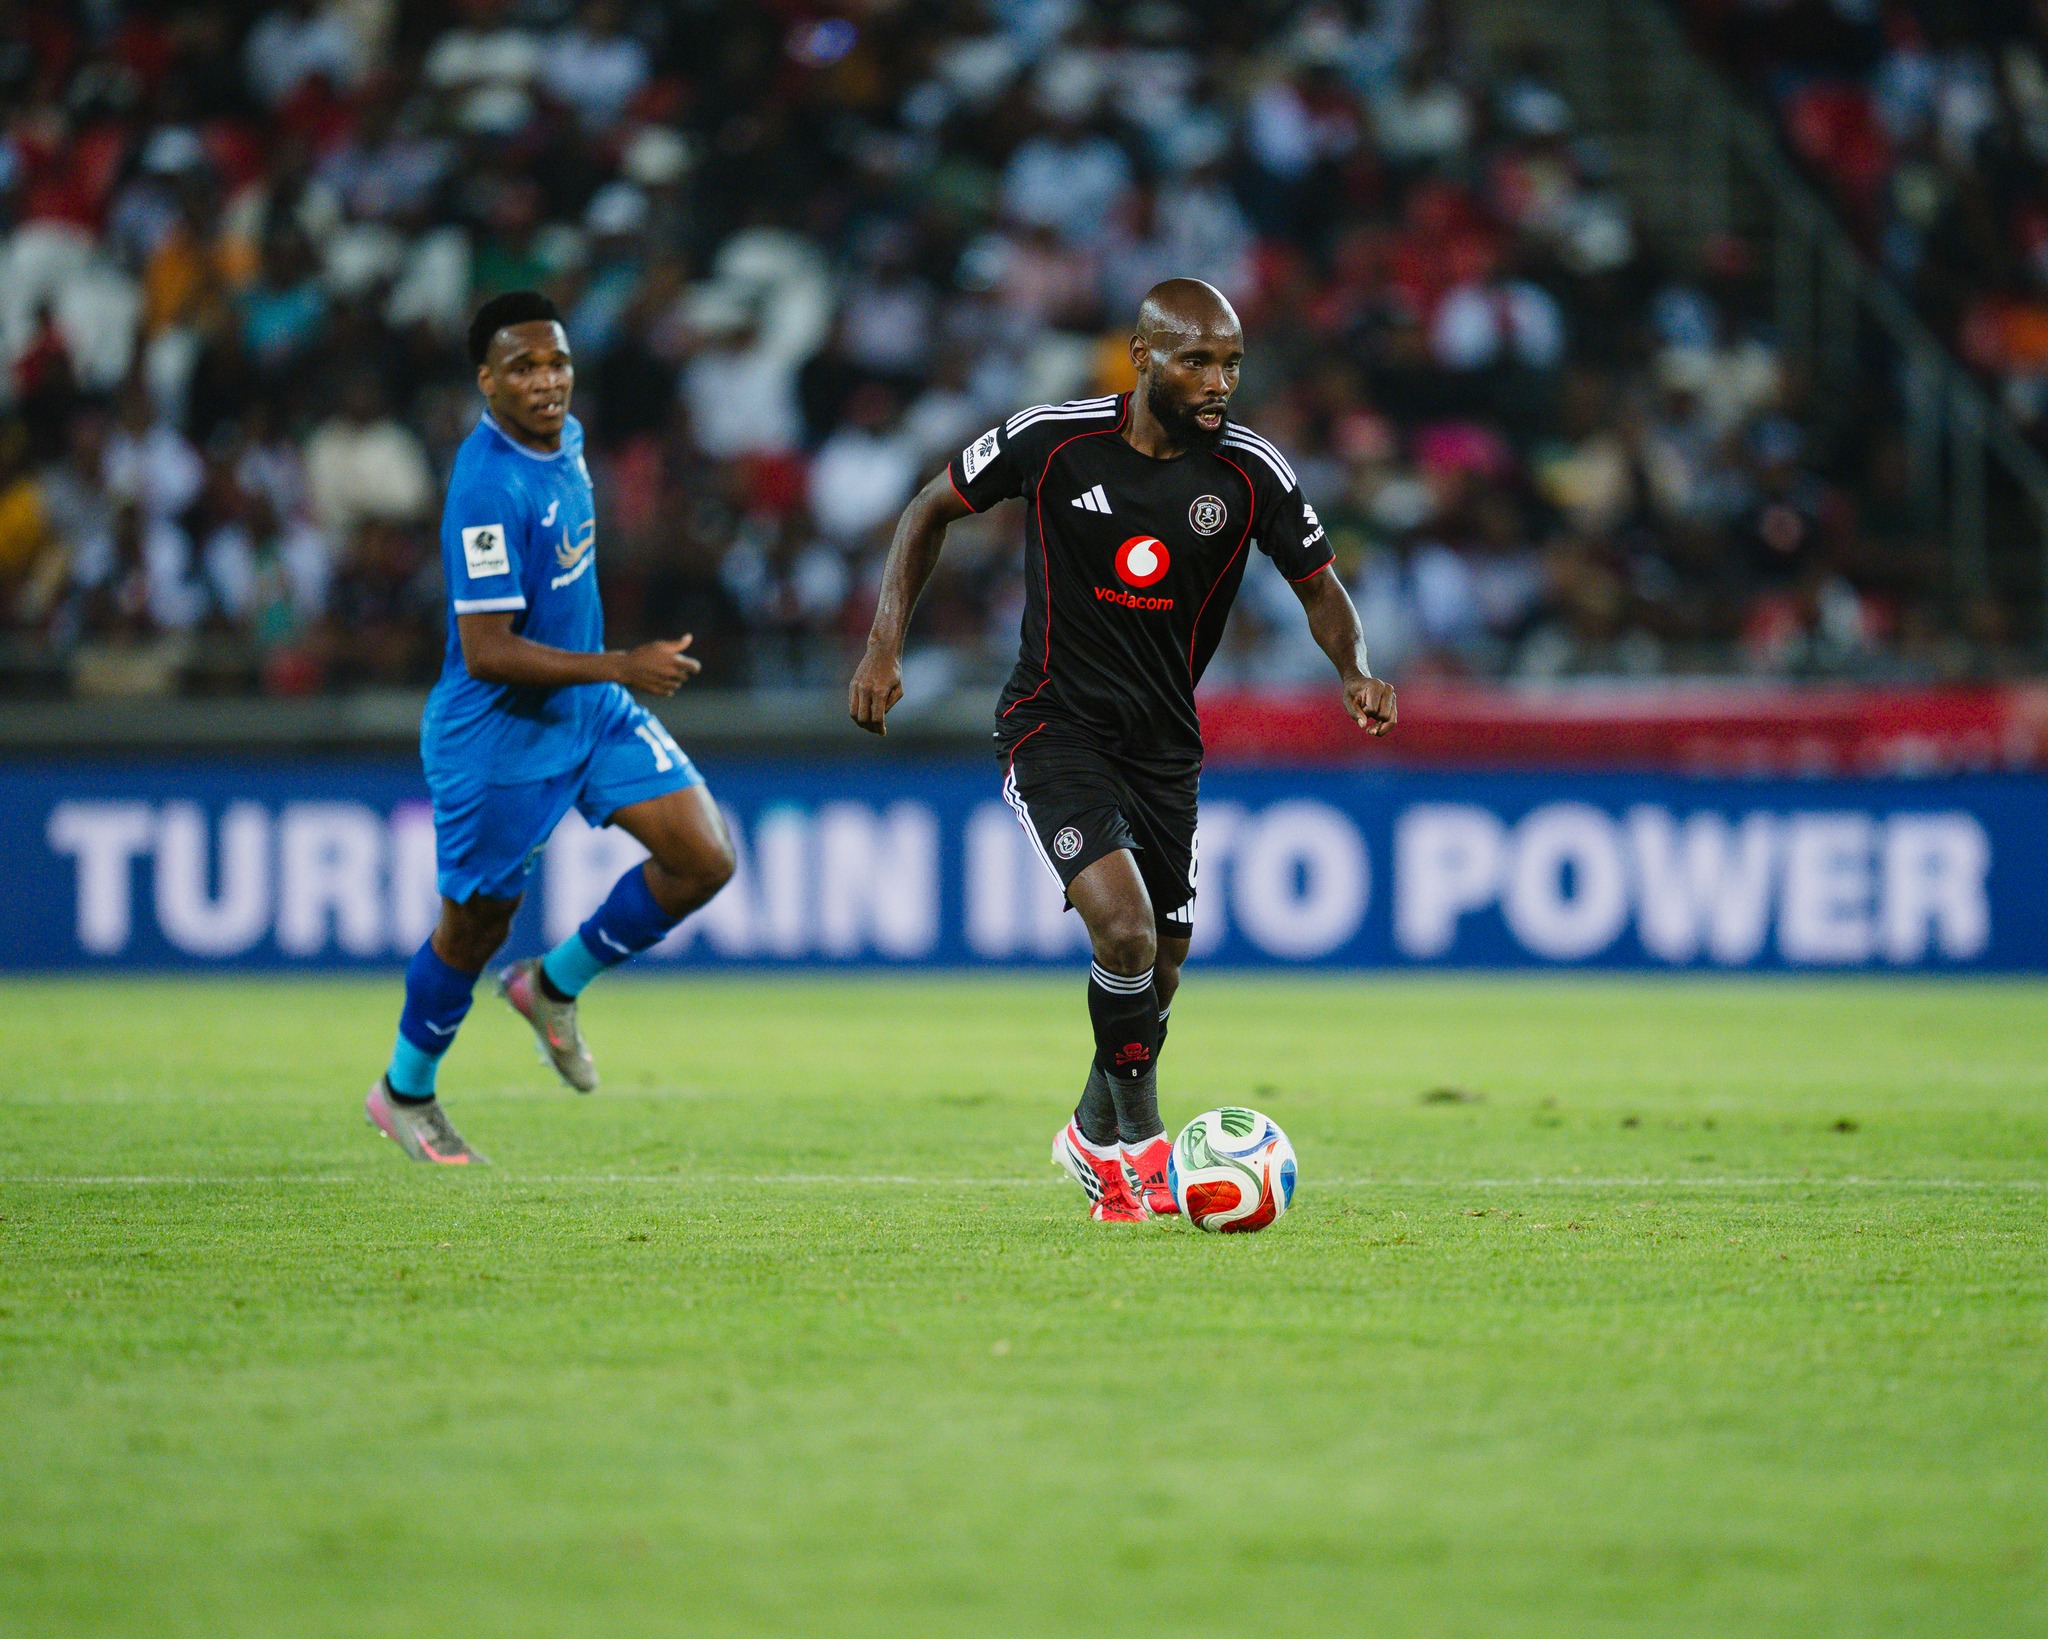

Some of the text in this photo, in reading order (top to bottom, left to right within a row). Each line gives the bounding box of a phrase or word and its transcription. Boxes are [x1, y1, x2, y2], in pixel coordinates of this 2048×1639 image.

[1094, 586, 1174, 611] vodacom
[965, 799, 1368, 959] ITO
[1398, 804, 1991, 962] POWER
[1132, 1068, 1137, 1077] 8
